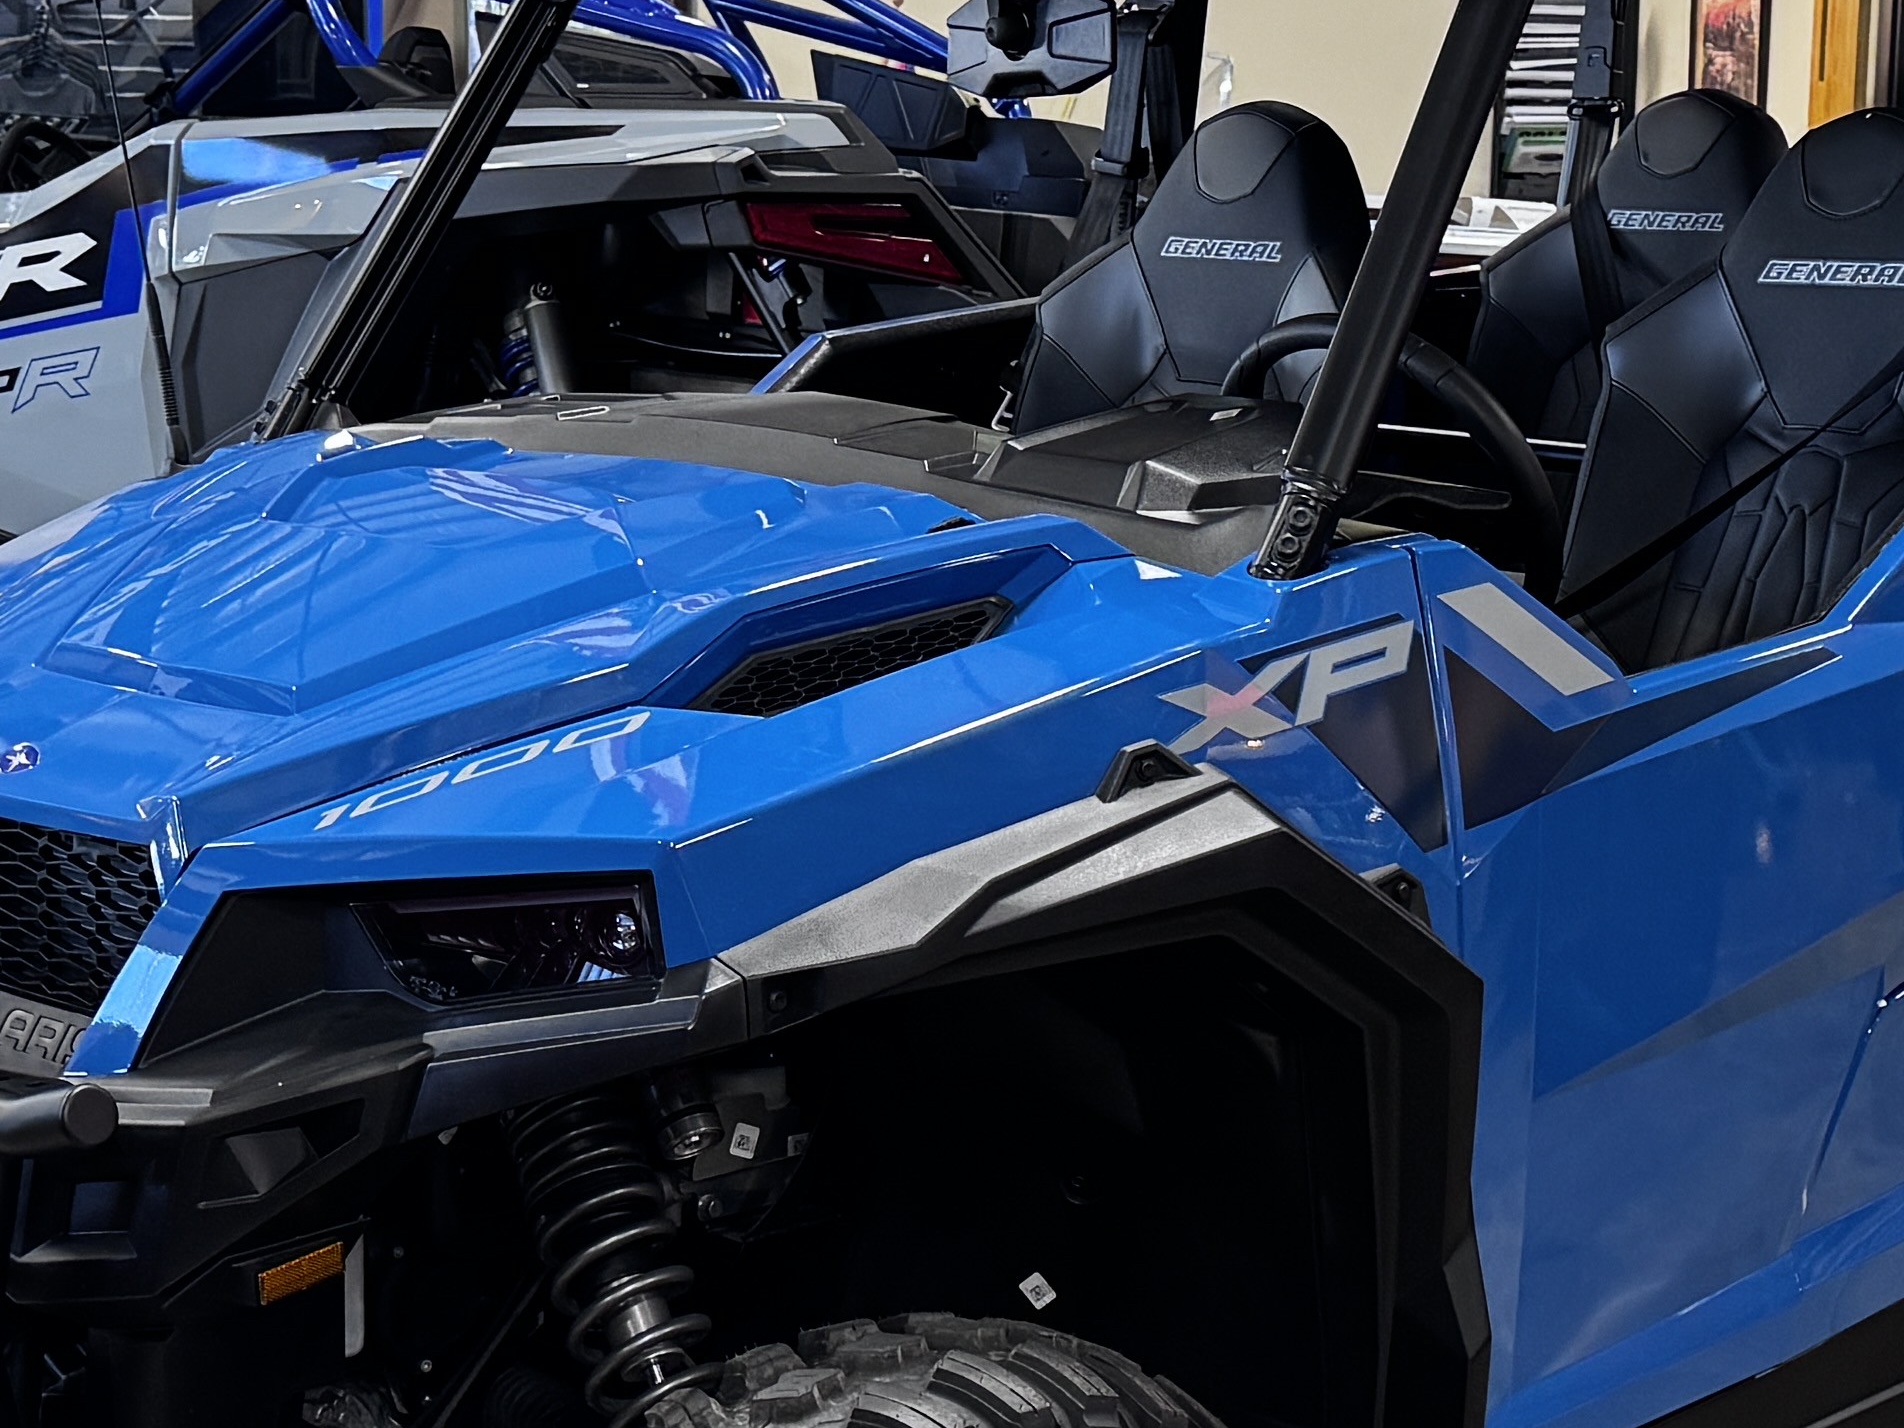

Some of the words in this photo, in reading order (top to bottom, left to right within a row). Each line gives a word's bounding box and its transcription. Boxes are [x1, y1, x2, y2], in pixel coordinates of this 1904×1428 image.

[1161, 237, 1283, 262] GENERAL
[1606, 210, 1725, 232] GENERAL
[1157, 619, 1414, 755] XP
[315, 711, 651, 831] 1000
